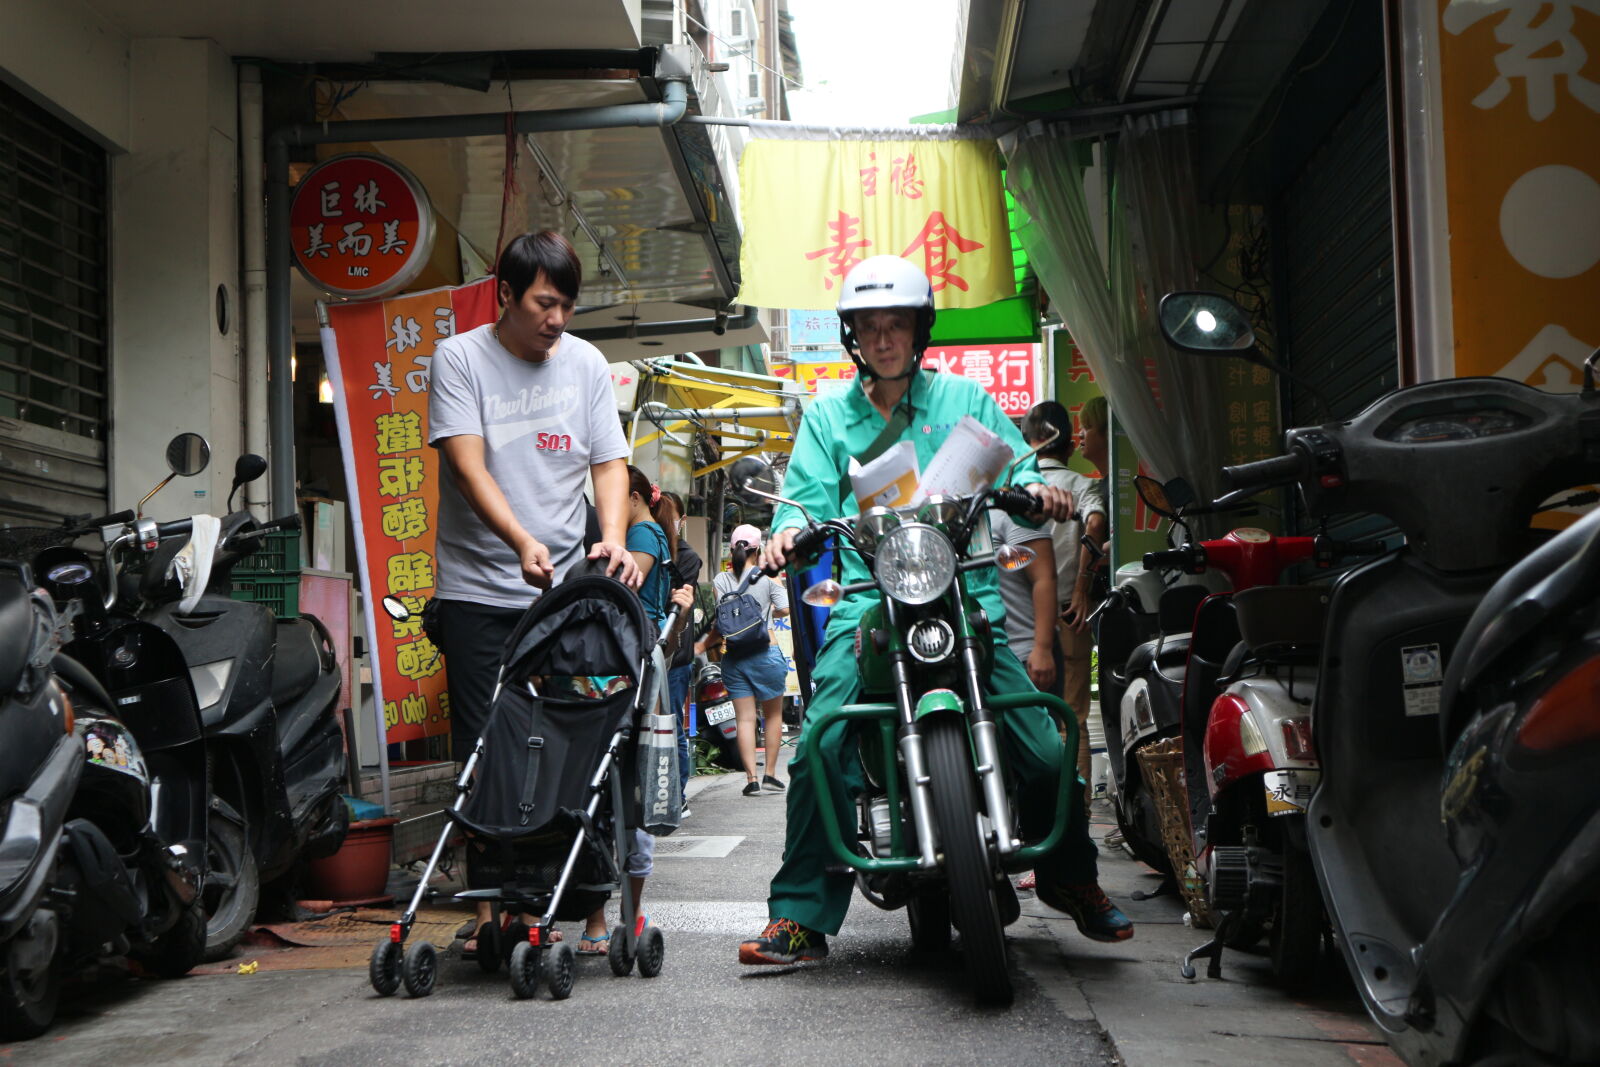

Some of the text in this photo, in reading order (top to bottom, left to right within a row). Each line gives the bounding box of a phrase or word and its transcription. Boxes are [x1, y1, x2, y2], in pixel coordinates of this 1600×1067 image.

[320, 178, 387, 217] 巨林
[303, 218, 408, 258] 美而美
[347, 266, 370, 277] LMC
[535, 432, 572, 452] 503
[652, 755, 670, 816] Roots
[1271, 783, 1313, 801] 永昌
